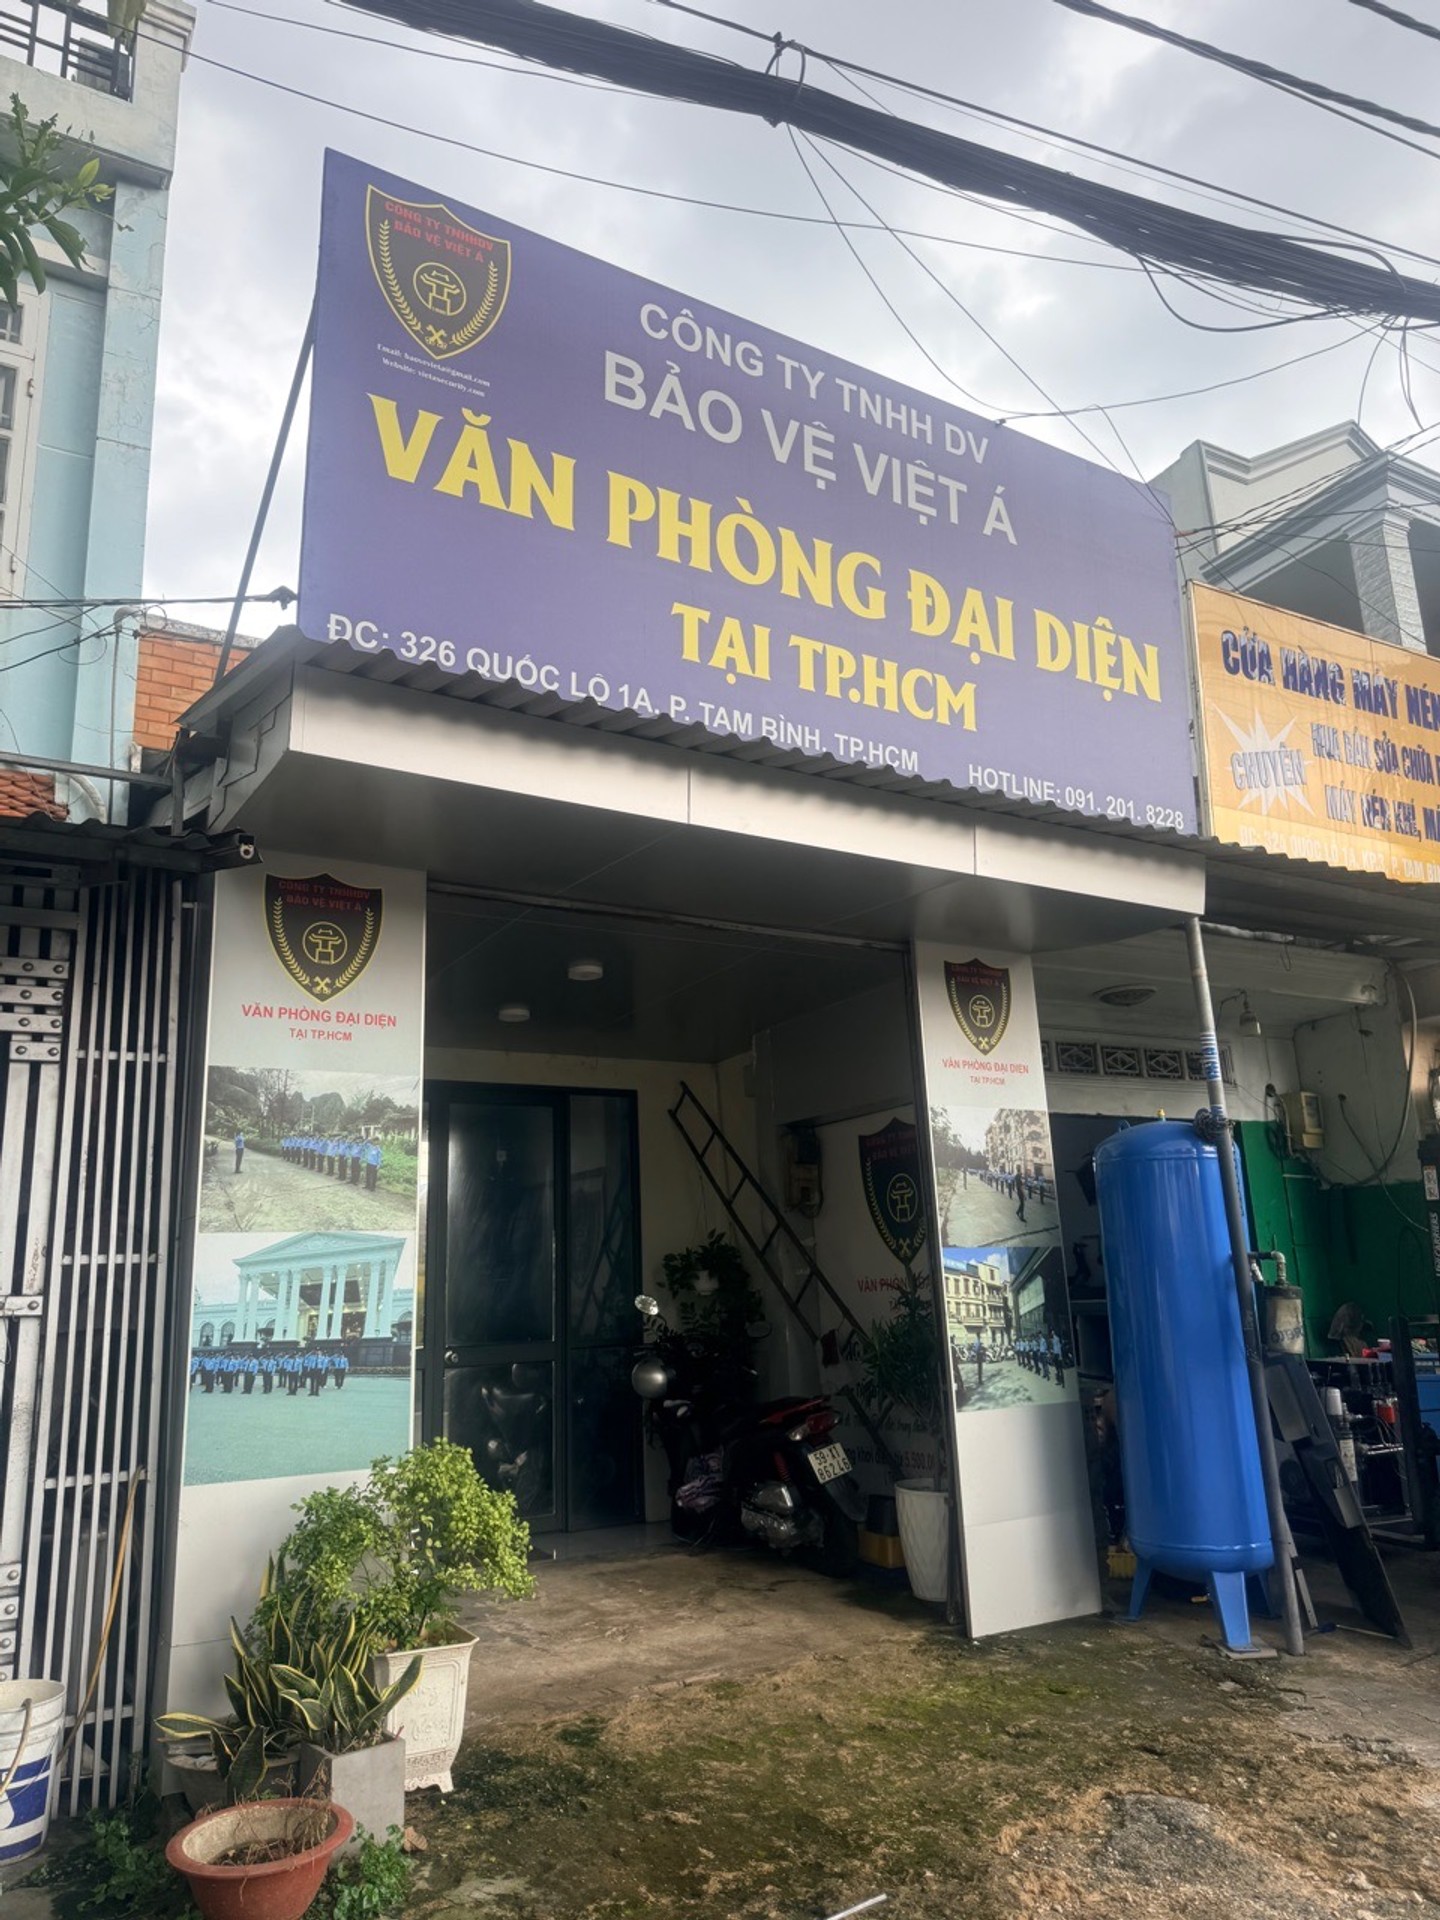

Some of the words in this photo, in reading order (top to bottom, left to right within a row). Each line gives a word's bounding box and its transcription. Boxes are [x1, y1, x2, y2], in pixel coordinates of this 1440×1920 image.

[640, 303, 764, 377] CÔNG
[776, 354, 824, 400] TY
[835, 377, 933, 445] TNHH
[944, 423, 989, 464] DV
[604, 350, 743, 444] BẢO
[762, 409, 836, 490] VỆ
[853, 442, 967, 526] VIỆT
[983, 486, 1017, 546] Á
[365, 392, 577, 531] VĂN
[606, 469, 886, 620] PHÒNG
[908, 568, 1016, 665] ĐẠI
[1033, 608, 1161, 703] DIỆN
[327, 613, 389, 649] ĐC:
[400, 631, 456, 667] 326
[466, 648, 560, 691] QUỐC
[570, 671, 610, 706] LỘ
[670, 694, 690, 721] P.
[699, 702, 753, 735] TAM
[834, 733, 918, 772] TP.HCM
[670, 602, 771, 684] TẠI
[789, 635, 977, 733] TP.HCM
[1220, 626, 1276, 686] CỬA
[1280, 645, 1346, 706] HÀNG
[1351, 668, 1399, 719] MÁY
[1230, 741, 1307, 790] CHUYÊN
[1311, 722, 1343, 763] MUA
[1374, 730, 1401, 776] SỬA
[1401, 744, 1435, 785] CHỮA
[969, 764, 1061, 804] HOTLINE:
[1065, 786, 1101, 812] 091.
[1106, 796, 1141, 821] 201.
[1146, 805, 1184, 830] 8228
[1325, 780, 1357, 824] MÁY
[1360, 788, 1391, 832] NÉN
[242, 1002, 273, 1018] VĂN
[278, 1006, 331, 1022] PHÒNG
[336, 1011, 360, 1027] ĐẠI
[364, 1012, 396, 1029] DIỆN
[290, 1028, 307, 1040] TẠI
[311, 1029, 352, 1041] TP.HCM
